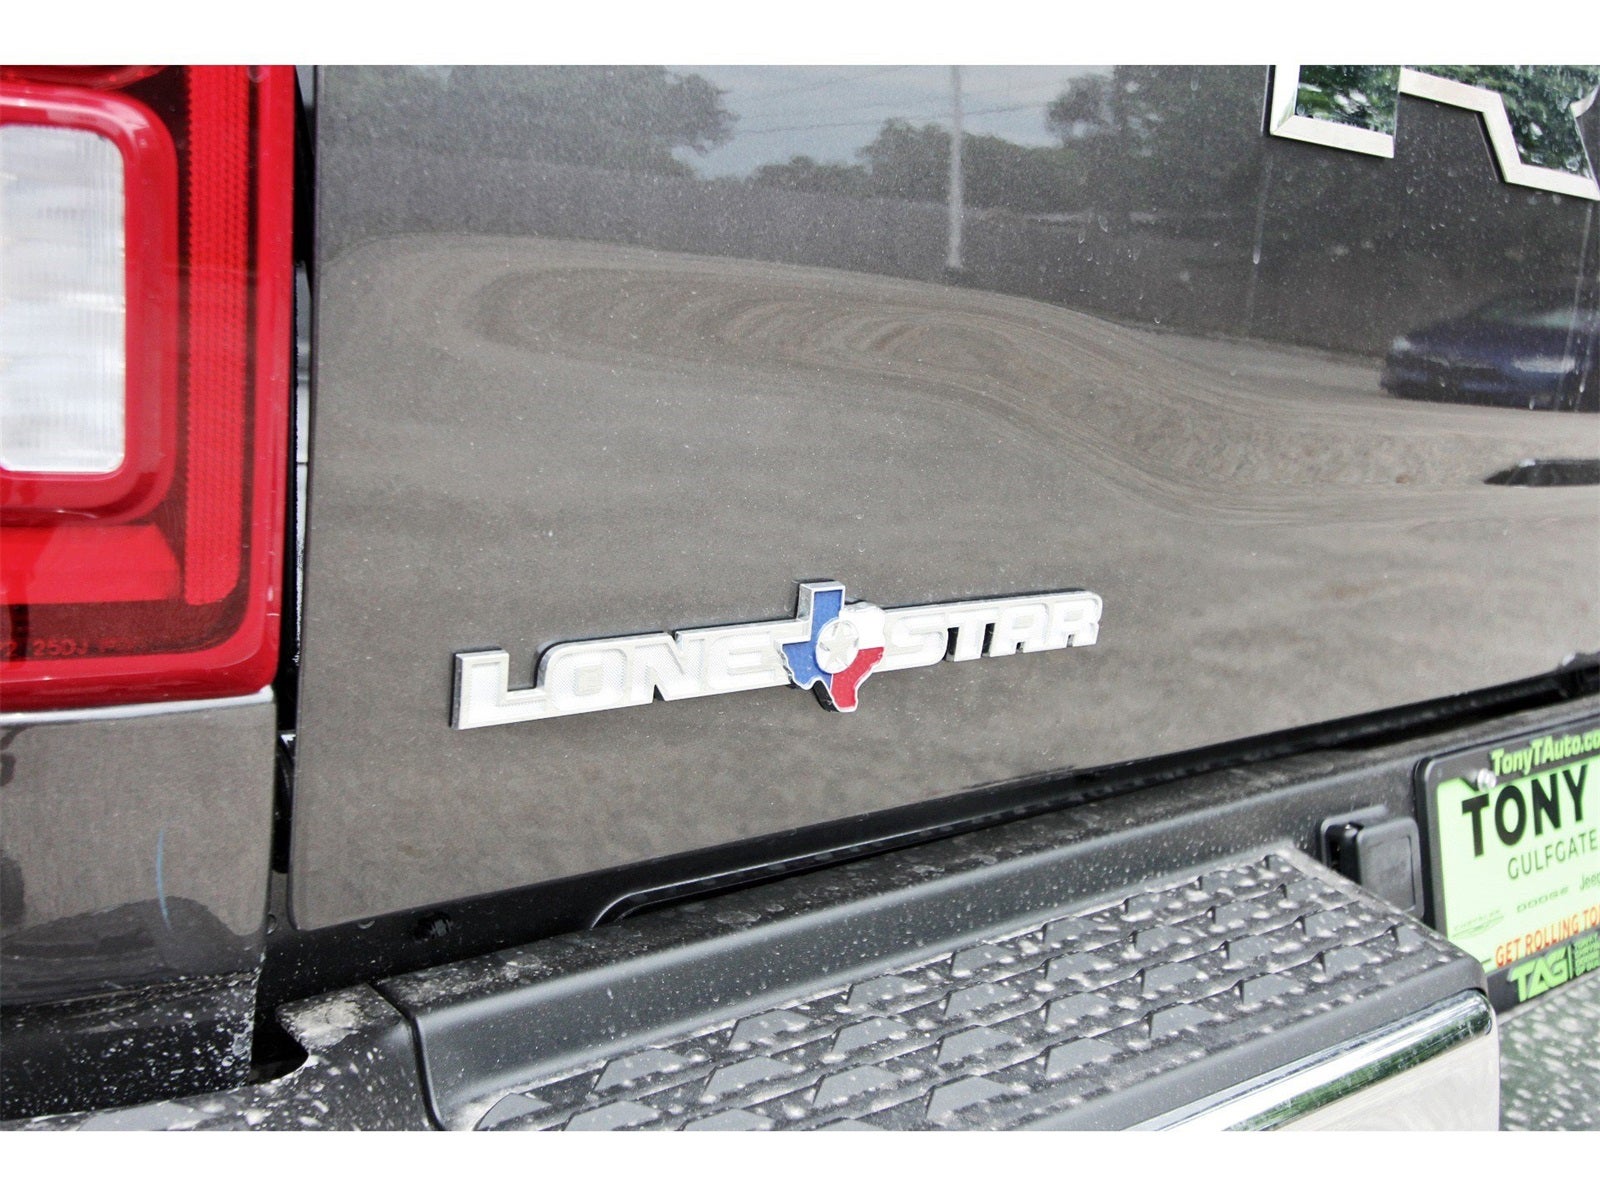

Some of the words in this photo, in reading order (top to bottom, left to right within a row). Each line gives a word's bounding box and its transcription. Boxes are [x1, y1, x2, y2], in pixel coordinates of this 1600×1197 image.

[452, 620, 786, 729] LONE
[878, 591, 1103, 671] STAR
[1462, 764, 1588, 857] TONY
[1508, 829, 1598, 879] GULFGATE
[1496, 938, 1521, 968] GET
[1525, 914, 1579, 956] ROLLING
[1583, 904, 1600, 931] TO
[1508, 946, 1568, 1003] TAG
